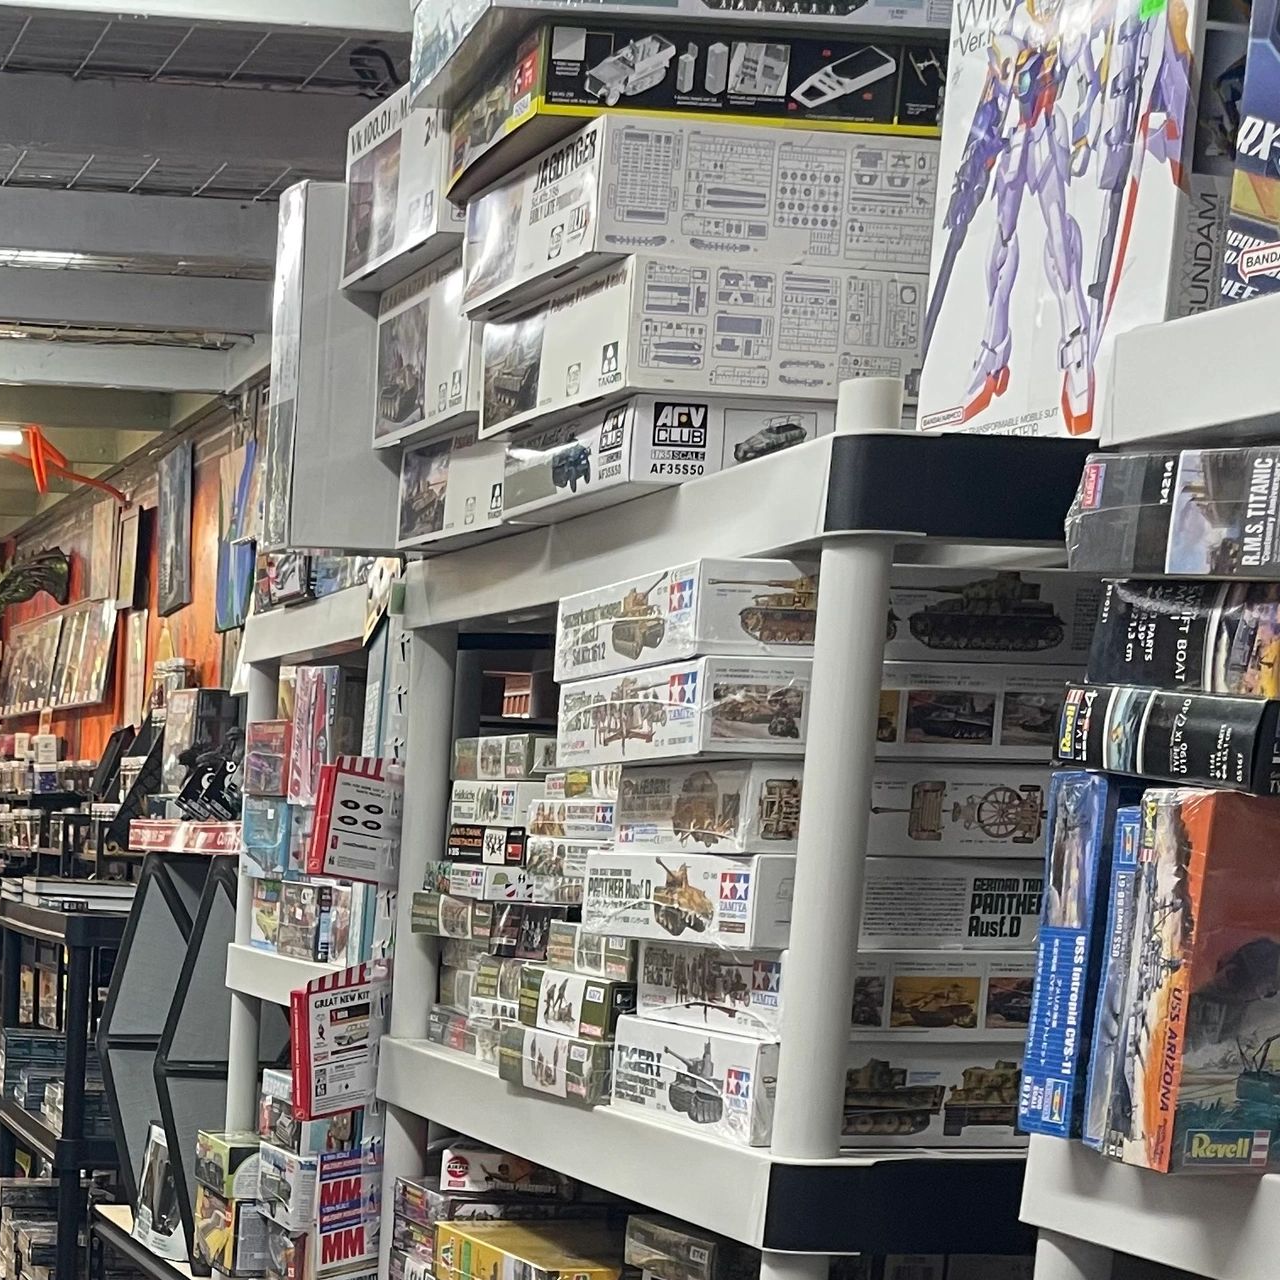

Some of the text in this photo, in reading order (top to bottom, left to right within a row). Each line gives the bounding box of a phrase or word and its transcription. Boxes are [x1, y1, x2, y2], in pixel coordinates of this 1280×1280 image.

[1246, 252, 1280, 268] BANDA
[656, 405, 706, 428] AFV
[1020, 413, 1044, 423] MOBILE
[656, 430, 704, 445] CLUB
[672, 450, 705, 461] SCALE
[650, 463, 704, 476] AF35S50
[1242, 457, 1273, 566] R.M.S. TITANIC
[1144, 623, 1156, 661] PARTS
[1061, 705, 1075, 752] Revell
[1075, 690, 1099, 761] LEVEL 4
[1172, 745, 1180, 772] TYPE
[1180, 742, 1188, 774] U190
[588, 879, 624, 898] PANTHER
[974, 878, 1043, 892] GERMAN TAN
[719, 902, 747, 912] TAMIYA
[968, 916, 1021, 937] Ausf.D
[1114, 909, 1124, 935] Iowa
[1073, 935, 1086, 964] USS
[314, 996, 339, 1009] GREAT
[340, 994, 356, 1004] NEW
[752, 993, 778, 1007] TAMIYA
[1061, 1028, 1077, 1075] CVS-11
[1159, 988, 1182, 1112] USS ARIZONA
[1191, 1133, 1251, 1161] Revell
[321, 1177, 361, 1204] MM
[322, 1227, 365, 1265] MM
